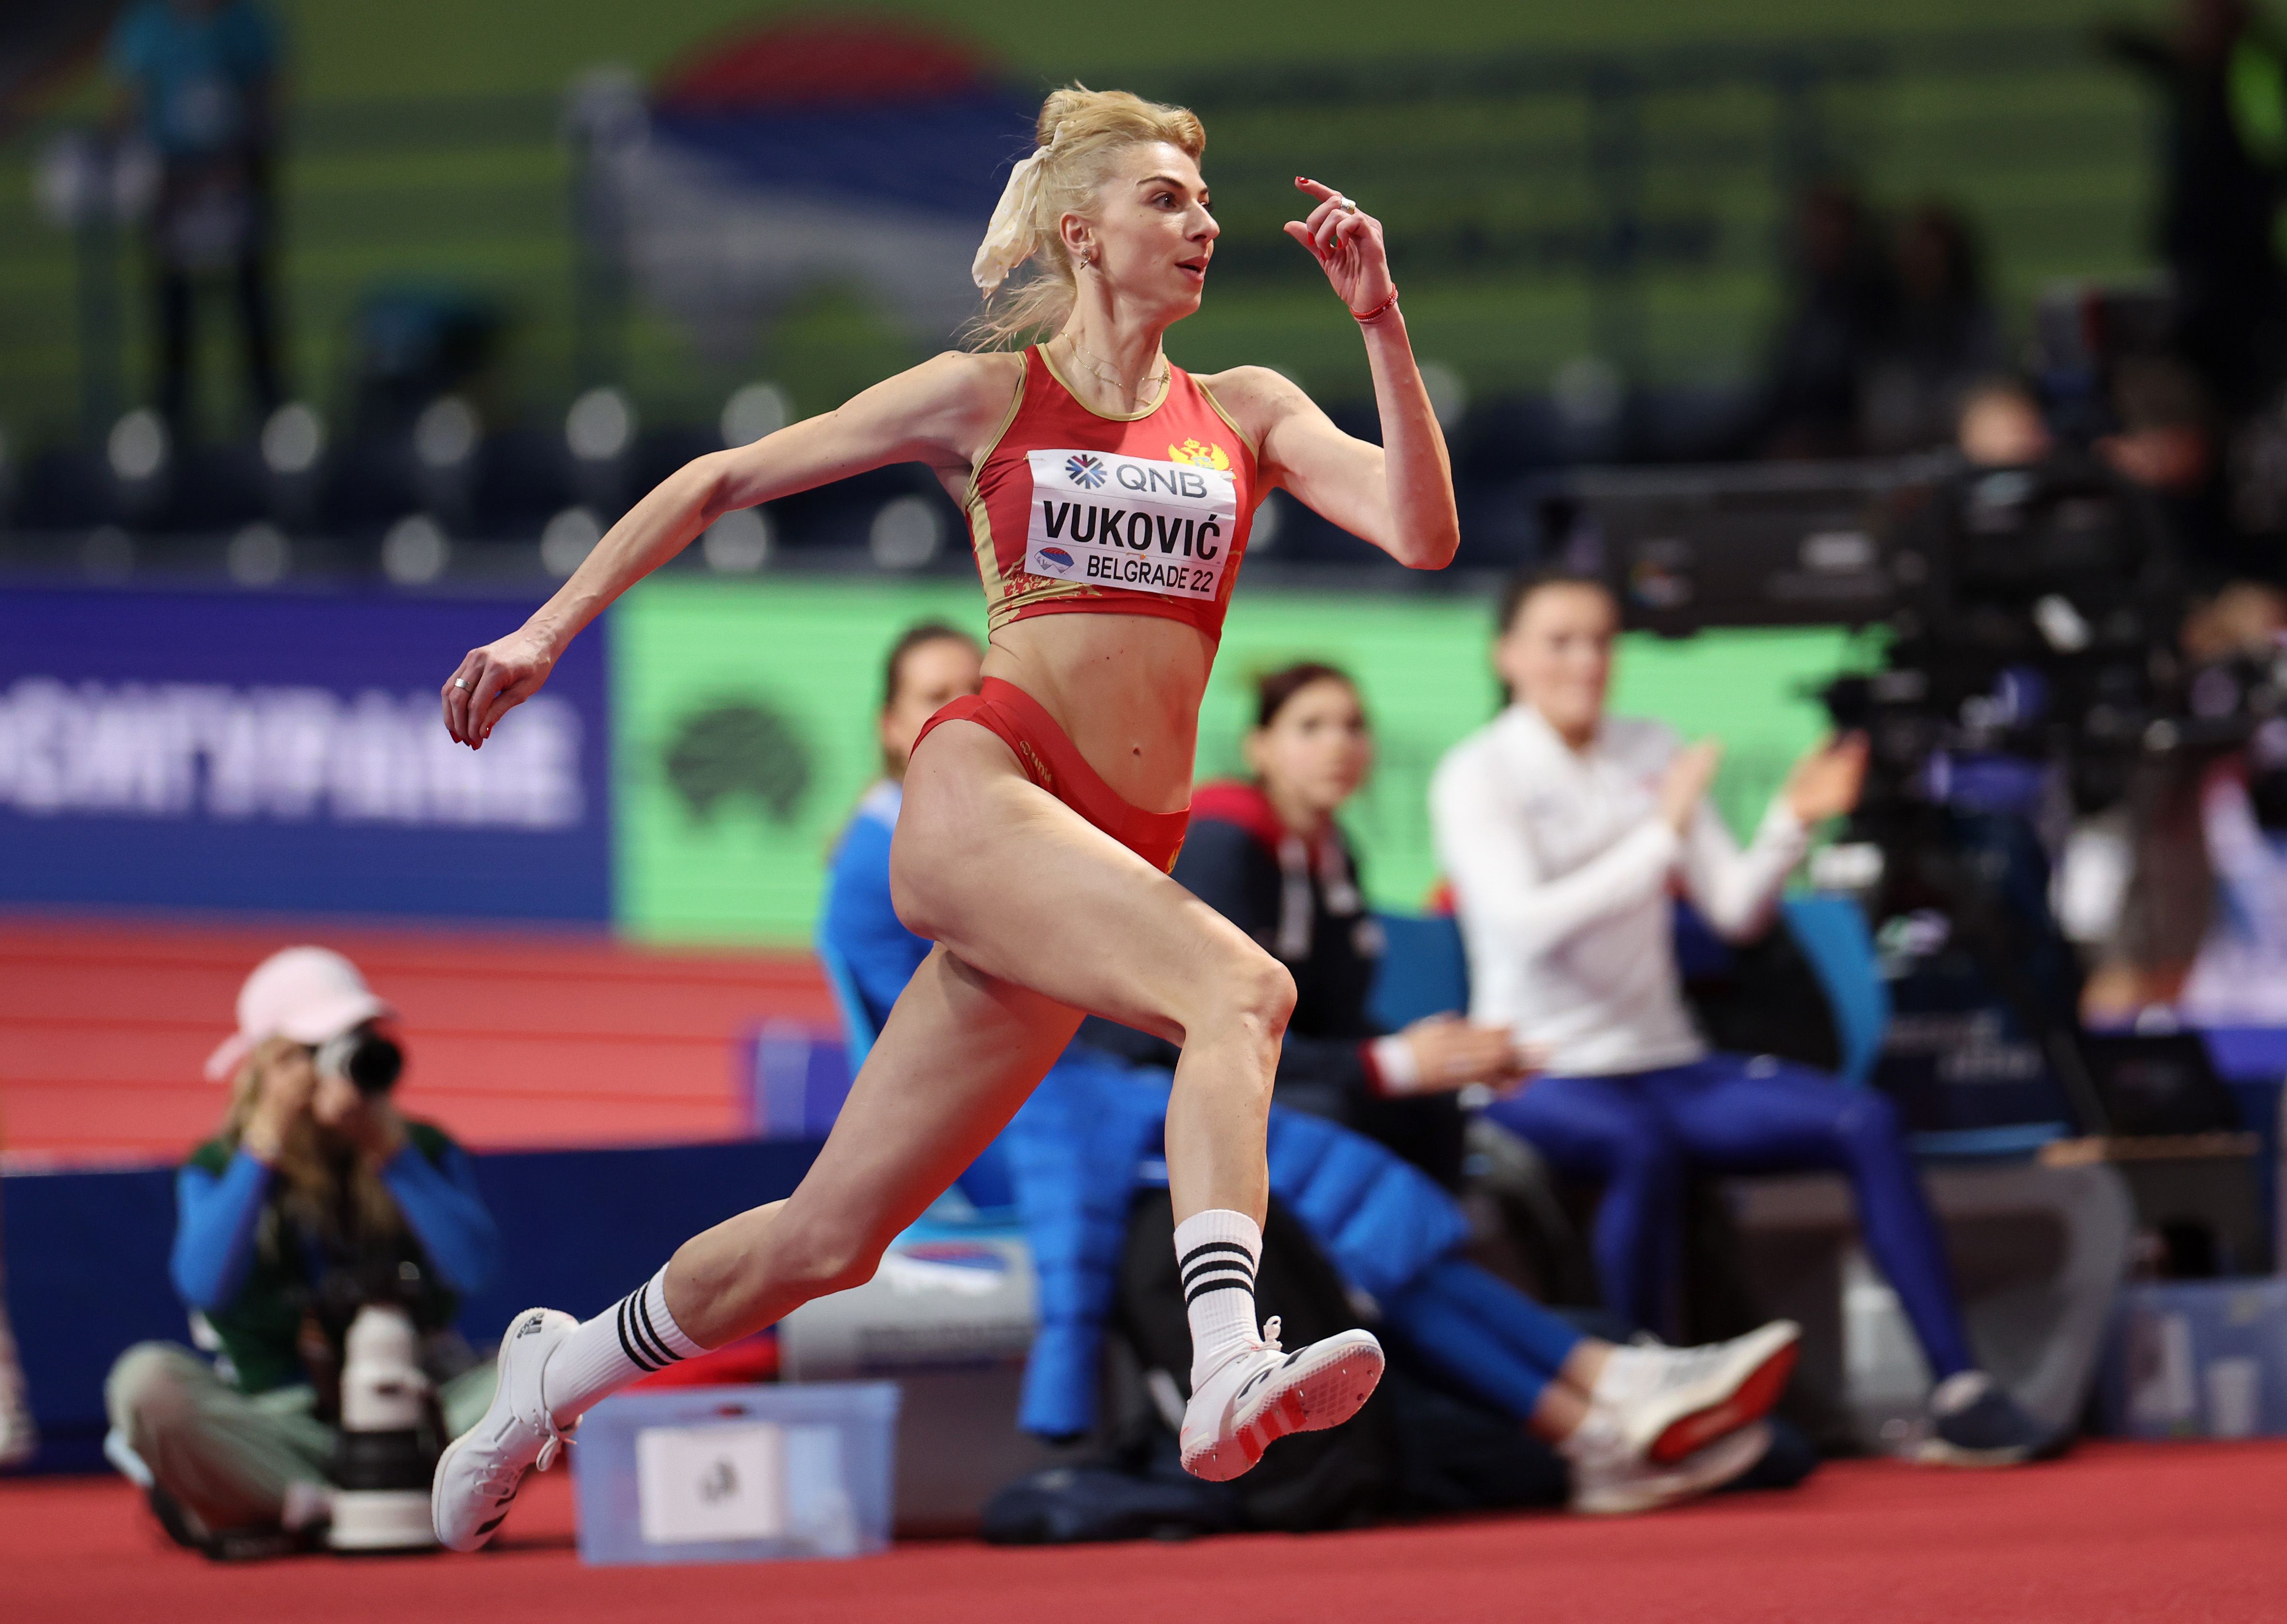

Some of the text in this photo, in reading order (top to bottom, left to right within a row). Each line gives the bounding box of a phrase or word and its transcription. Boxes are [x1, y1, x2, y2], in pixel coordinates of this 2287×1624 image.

[1116, 464, 1207, 499] QNB
[1043, 500, 1220, 561] VUKOVIĆ
[1087, 555, 1214, 592] BELGRADE 22
